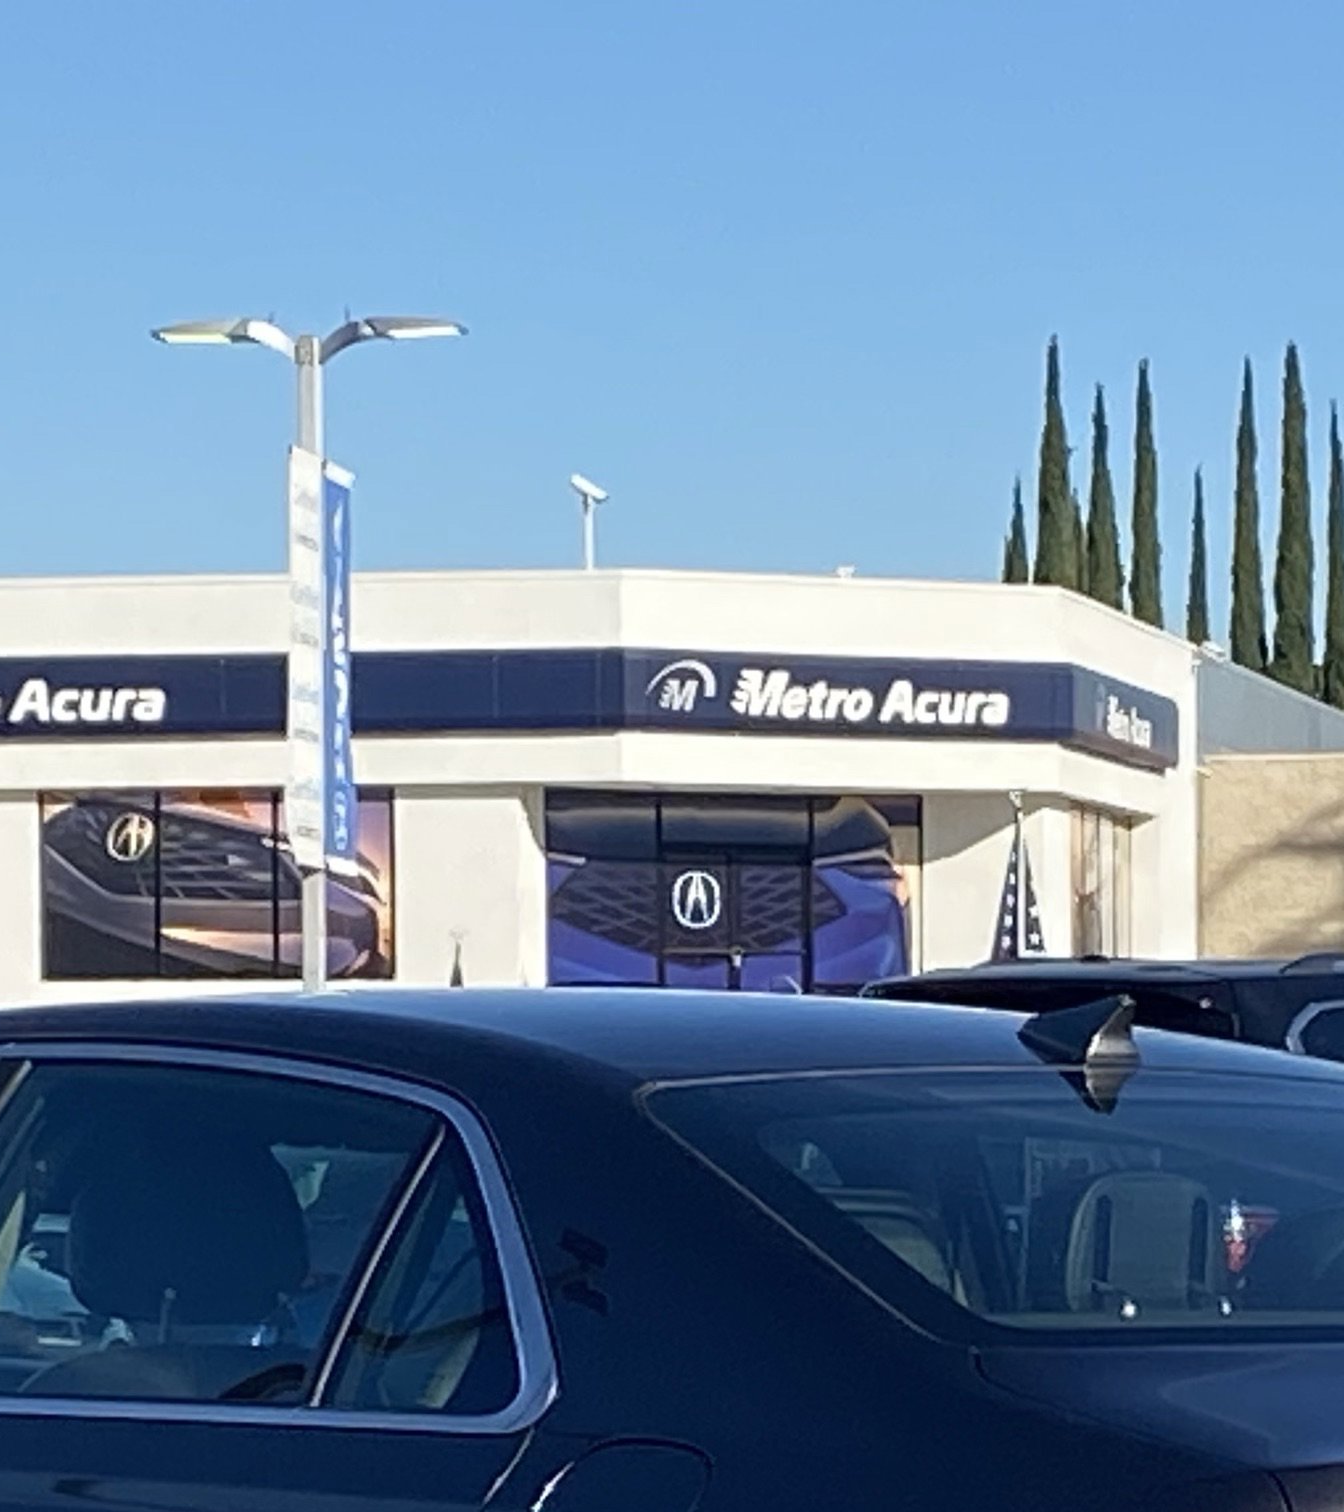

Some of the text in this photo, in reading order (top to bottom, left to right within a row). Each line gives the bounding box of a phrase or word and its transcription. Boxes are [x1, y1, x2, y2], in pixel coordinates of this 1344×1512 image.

[8, 677, 167, 723] Acura
[729, 668, 1011, 726] Metro Acura
